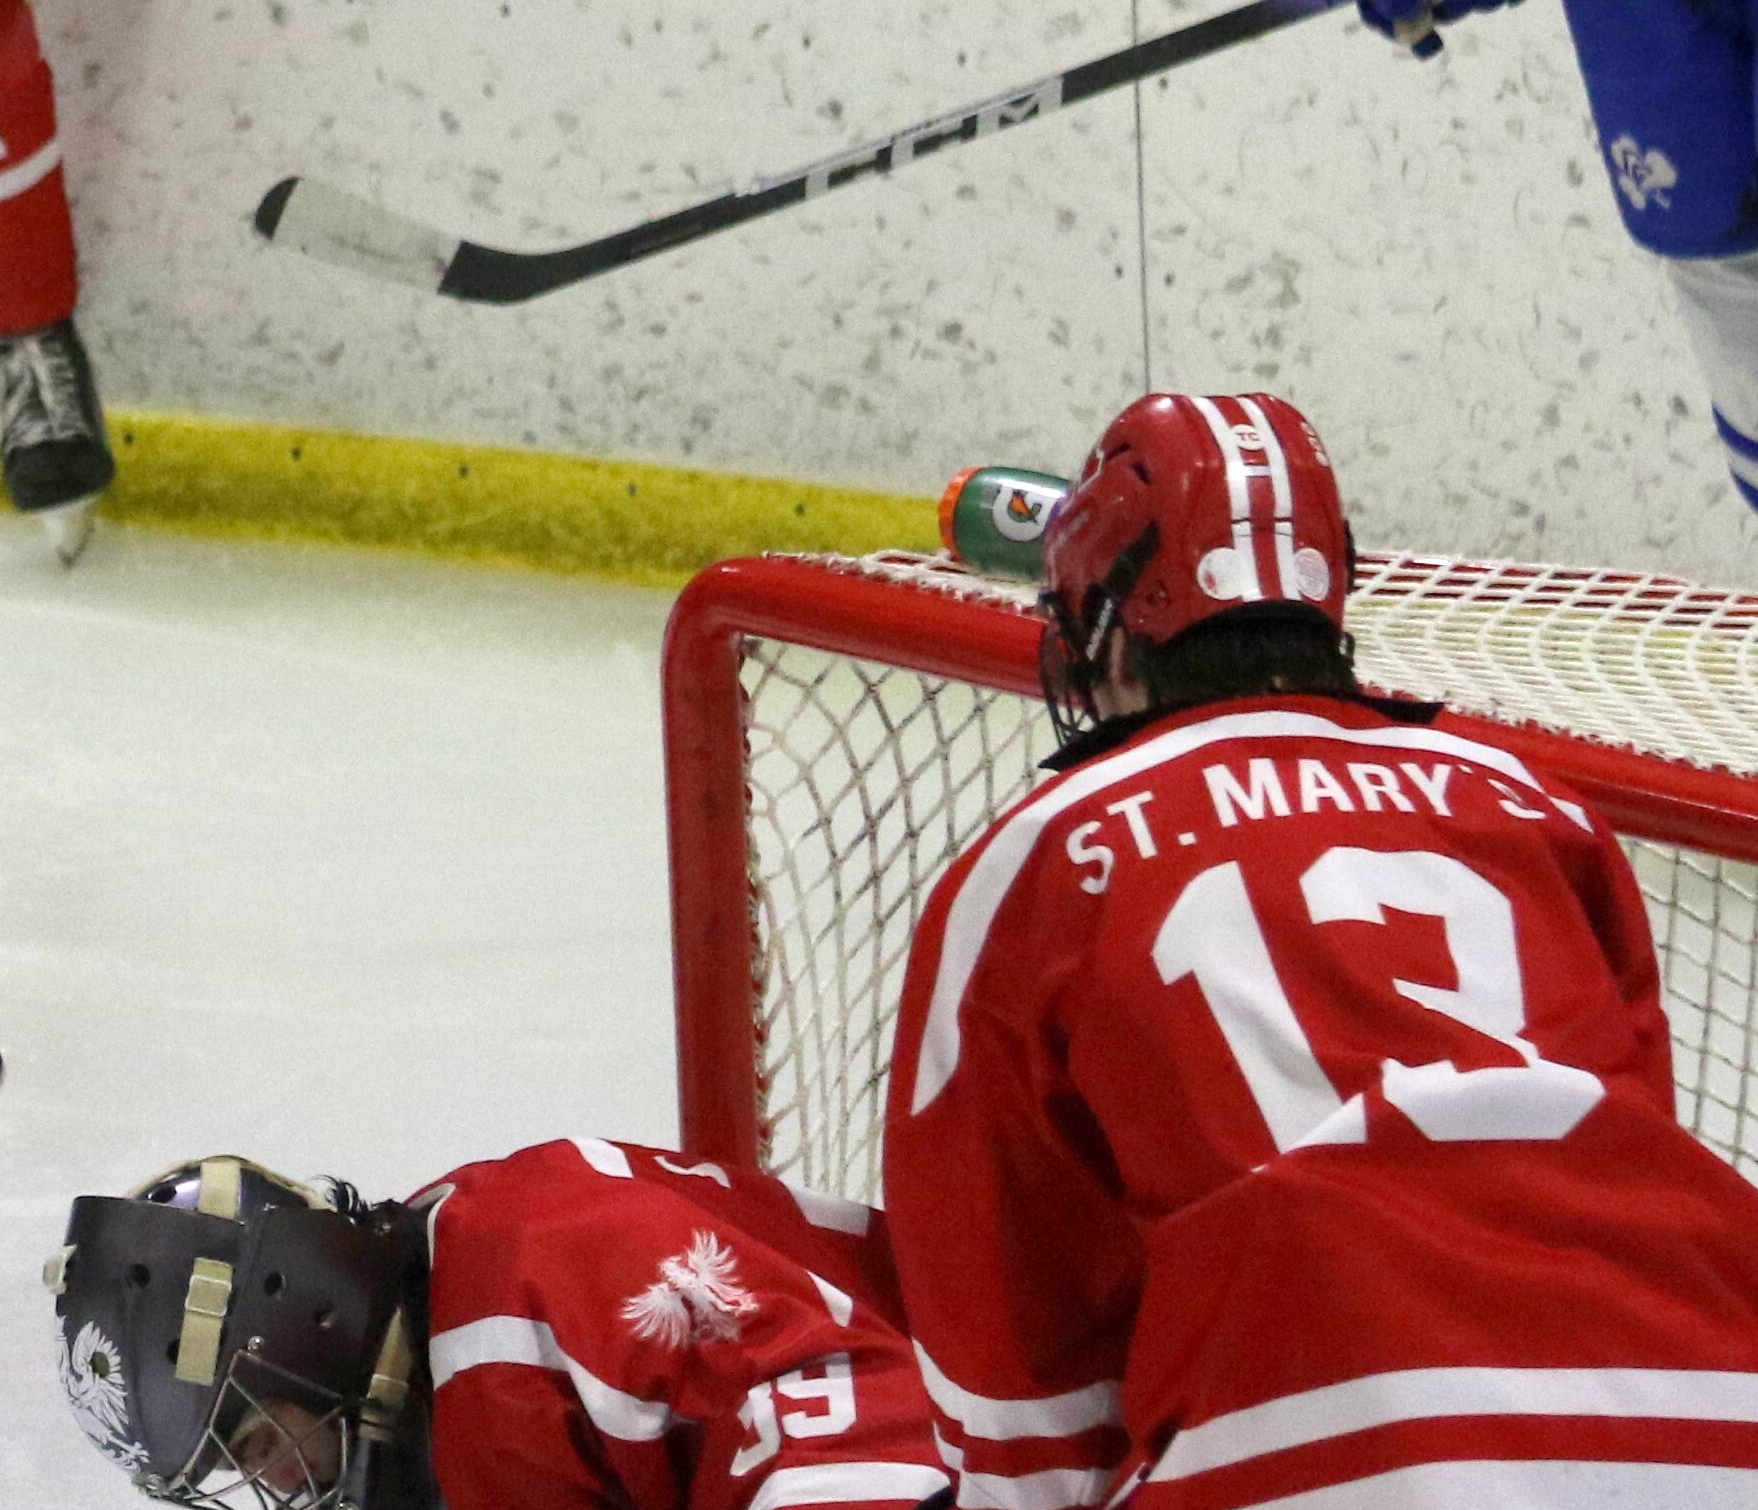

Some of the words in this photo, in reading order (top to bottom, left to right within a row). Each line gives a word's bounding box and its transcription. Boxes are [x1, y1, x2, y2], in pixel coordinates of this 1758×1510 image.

[803, 74, 1063, 202] CCM
[1065, 790, 1197, 896] ST.
[1151, 845, 1607, 1154] 13
